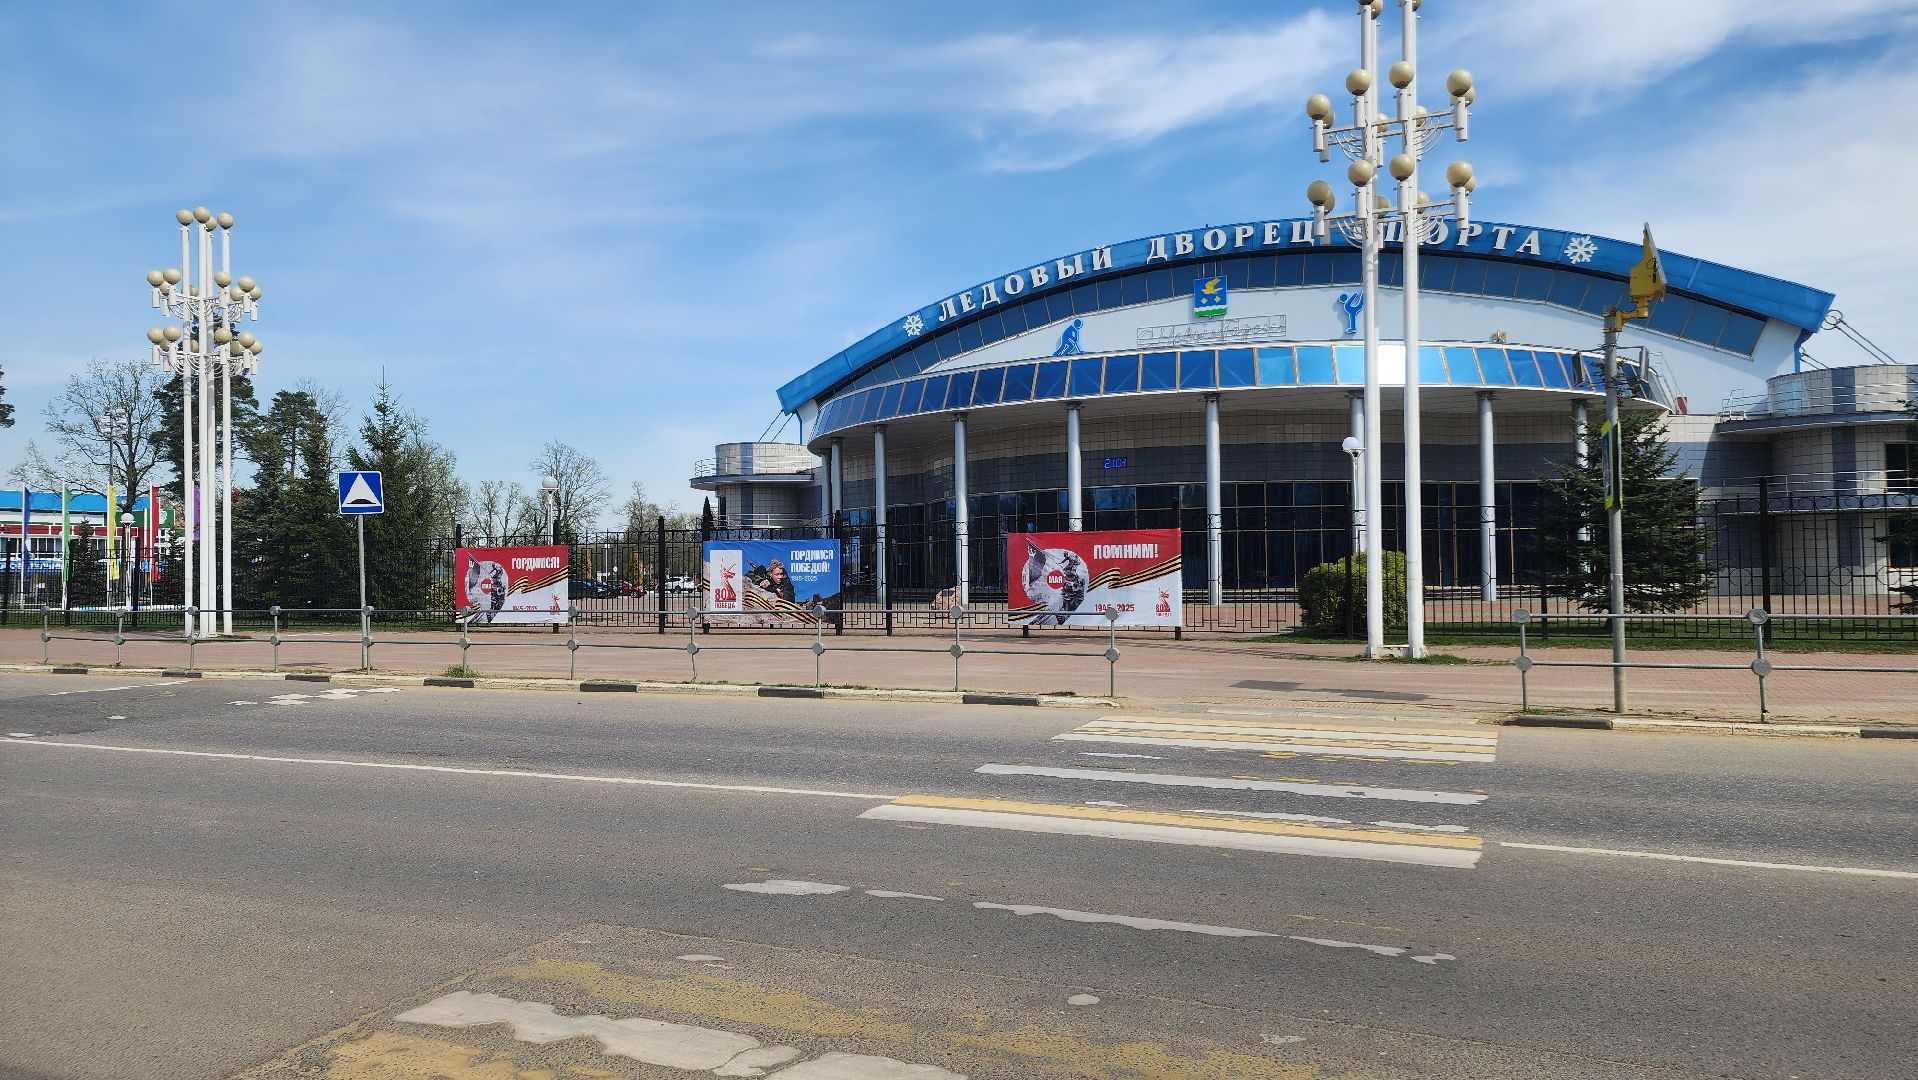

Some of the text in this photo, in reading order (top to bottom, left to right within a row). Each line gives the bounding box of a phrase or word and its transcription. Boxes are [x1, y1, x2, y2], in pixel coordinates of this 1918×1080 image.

[938, 244, 1113, 322] ЛЕДОВЫЙ
[1146, 219, 1315, 266] ДВОРЕЦ
[790, 549, 834, 562] ГОРДИМСЯ
[1093, 543, 1160, 560] ПОМНИМ!
[511, 557, 560, 571] ГОРДИМСЯ!
[790, 562, 831, 575] ПОБЕДОЙ!
[1048, 575, 1063, 584] МАЯ
[714, 588, 727, 601] 80
